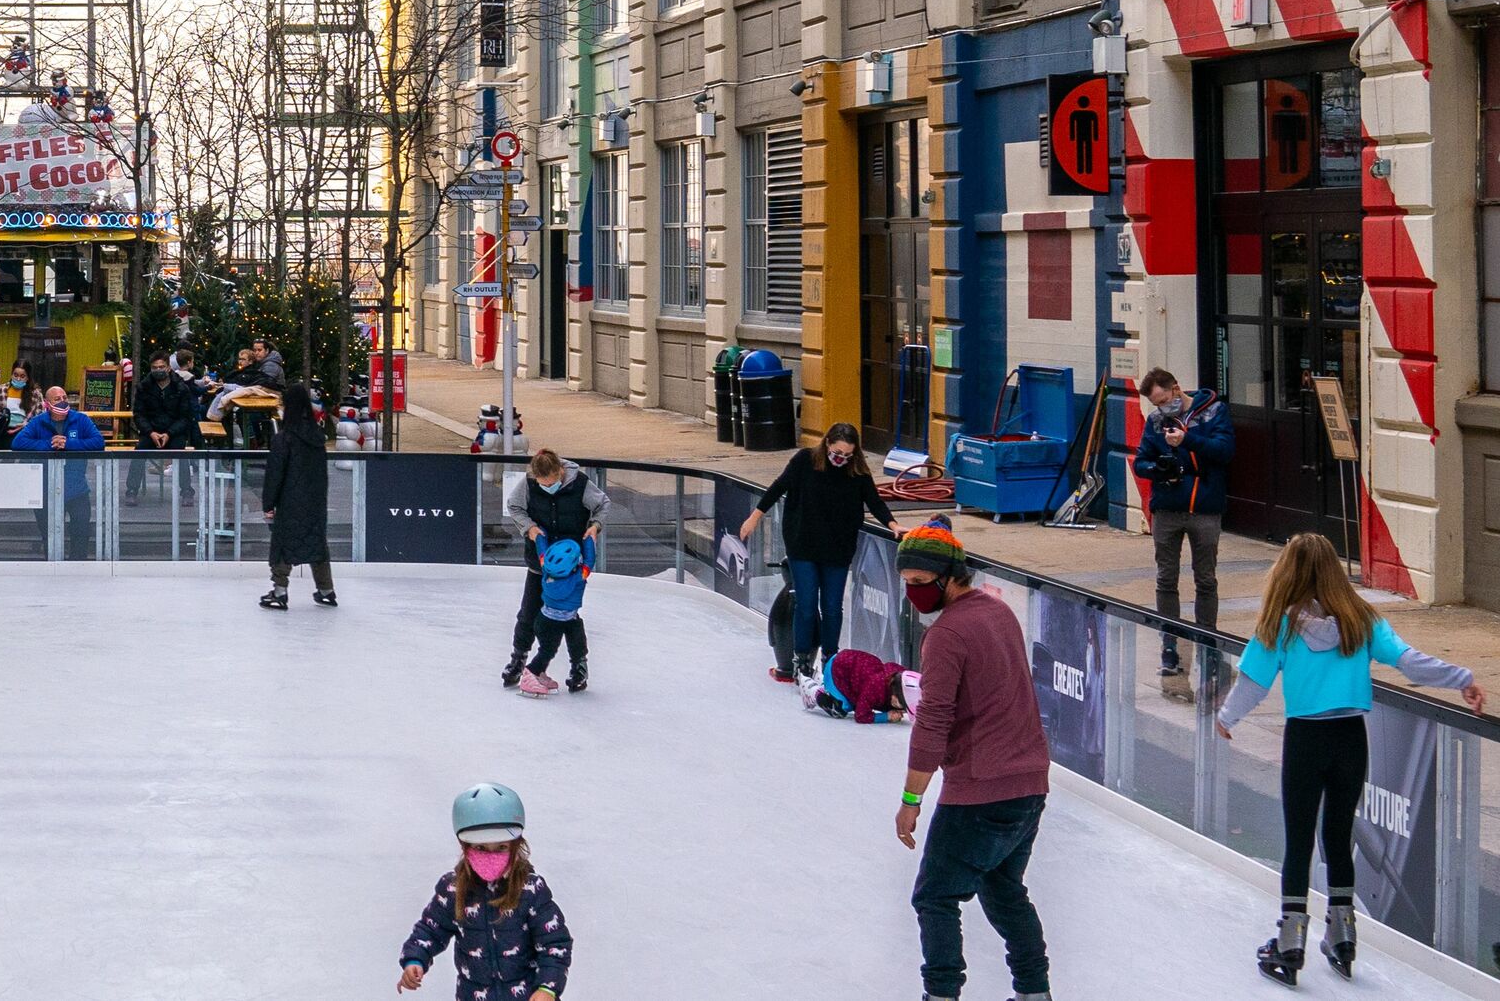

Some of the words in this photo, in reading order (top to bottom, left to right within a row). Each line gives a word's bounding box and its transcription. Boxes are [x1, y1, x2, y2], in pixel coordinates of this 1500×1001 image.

[1120, 303, 1132, 312] MEN
[389, 508, 454, 517] VOLVO
[1053, 660, 1084, 702] CREATES
[1363, 781, 1411, 839] FUTURE
